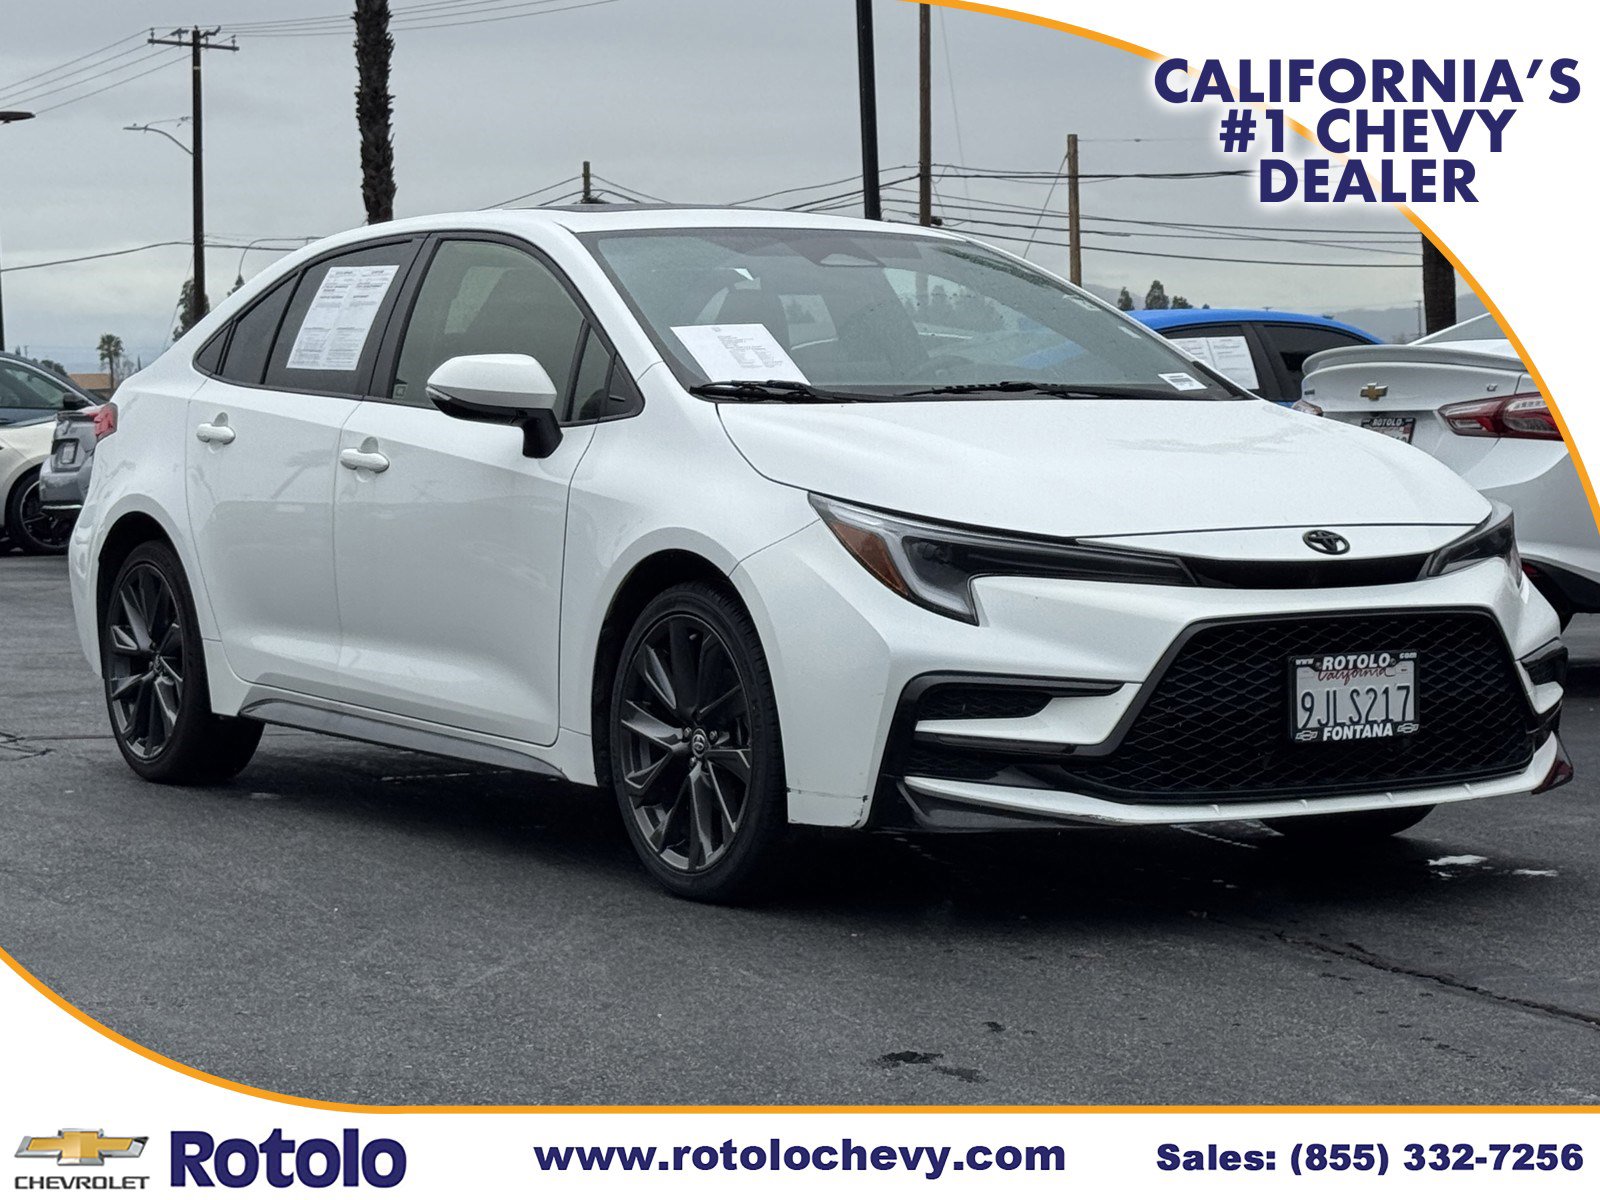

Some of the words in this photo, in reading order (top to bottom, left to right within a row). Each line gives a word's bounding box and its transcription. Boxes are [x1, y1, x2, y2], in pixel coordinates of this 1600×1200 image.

[1372, 418, 1402, 427] ROTOLO
[1322, 652, 1391, 671] ROTOLO
[1301, 685, 1411, 729] 9JLS217
[1322, 722, 1393, 742] FONTANA
